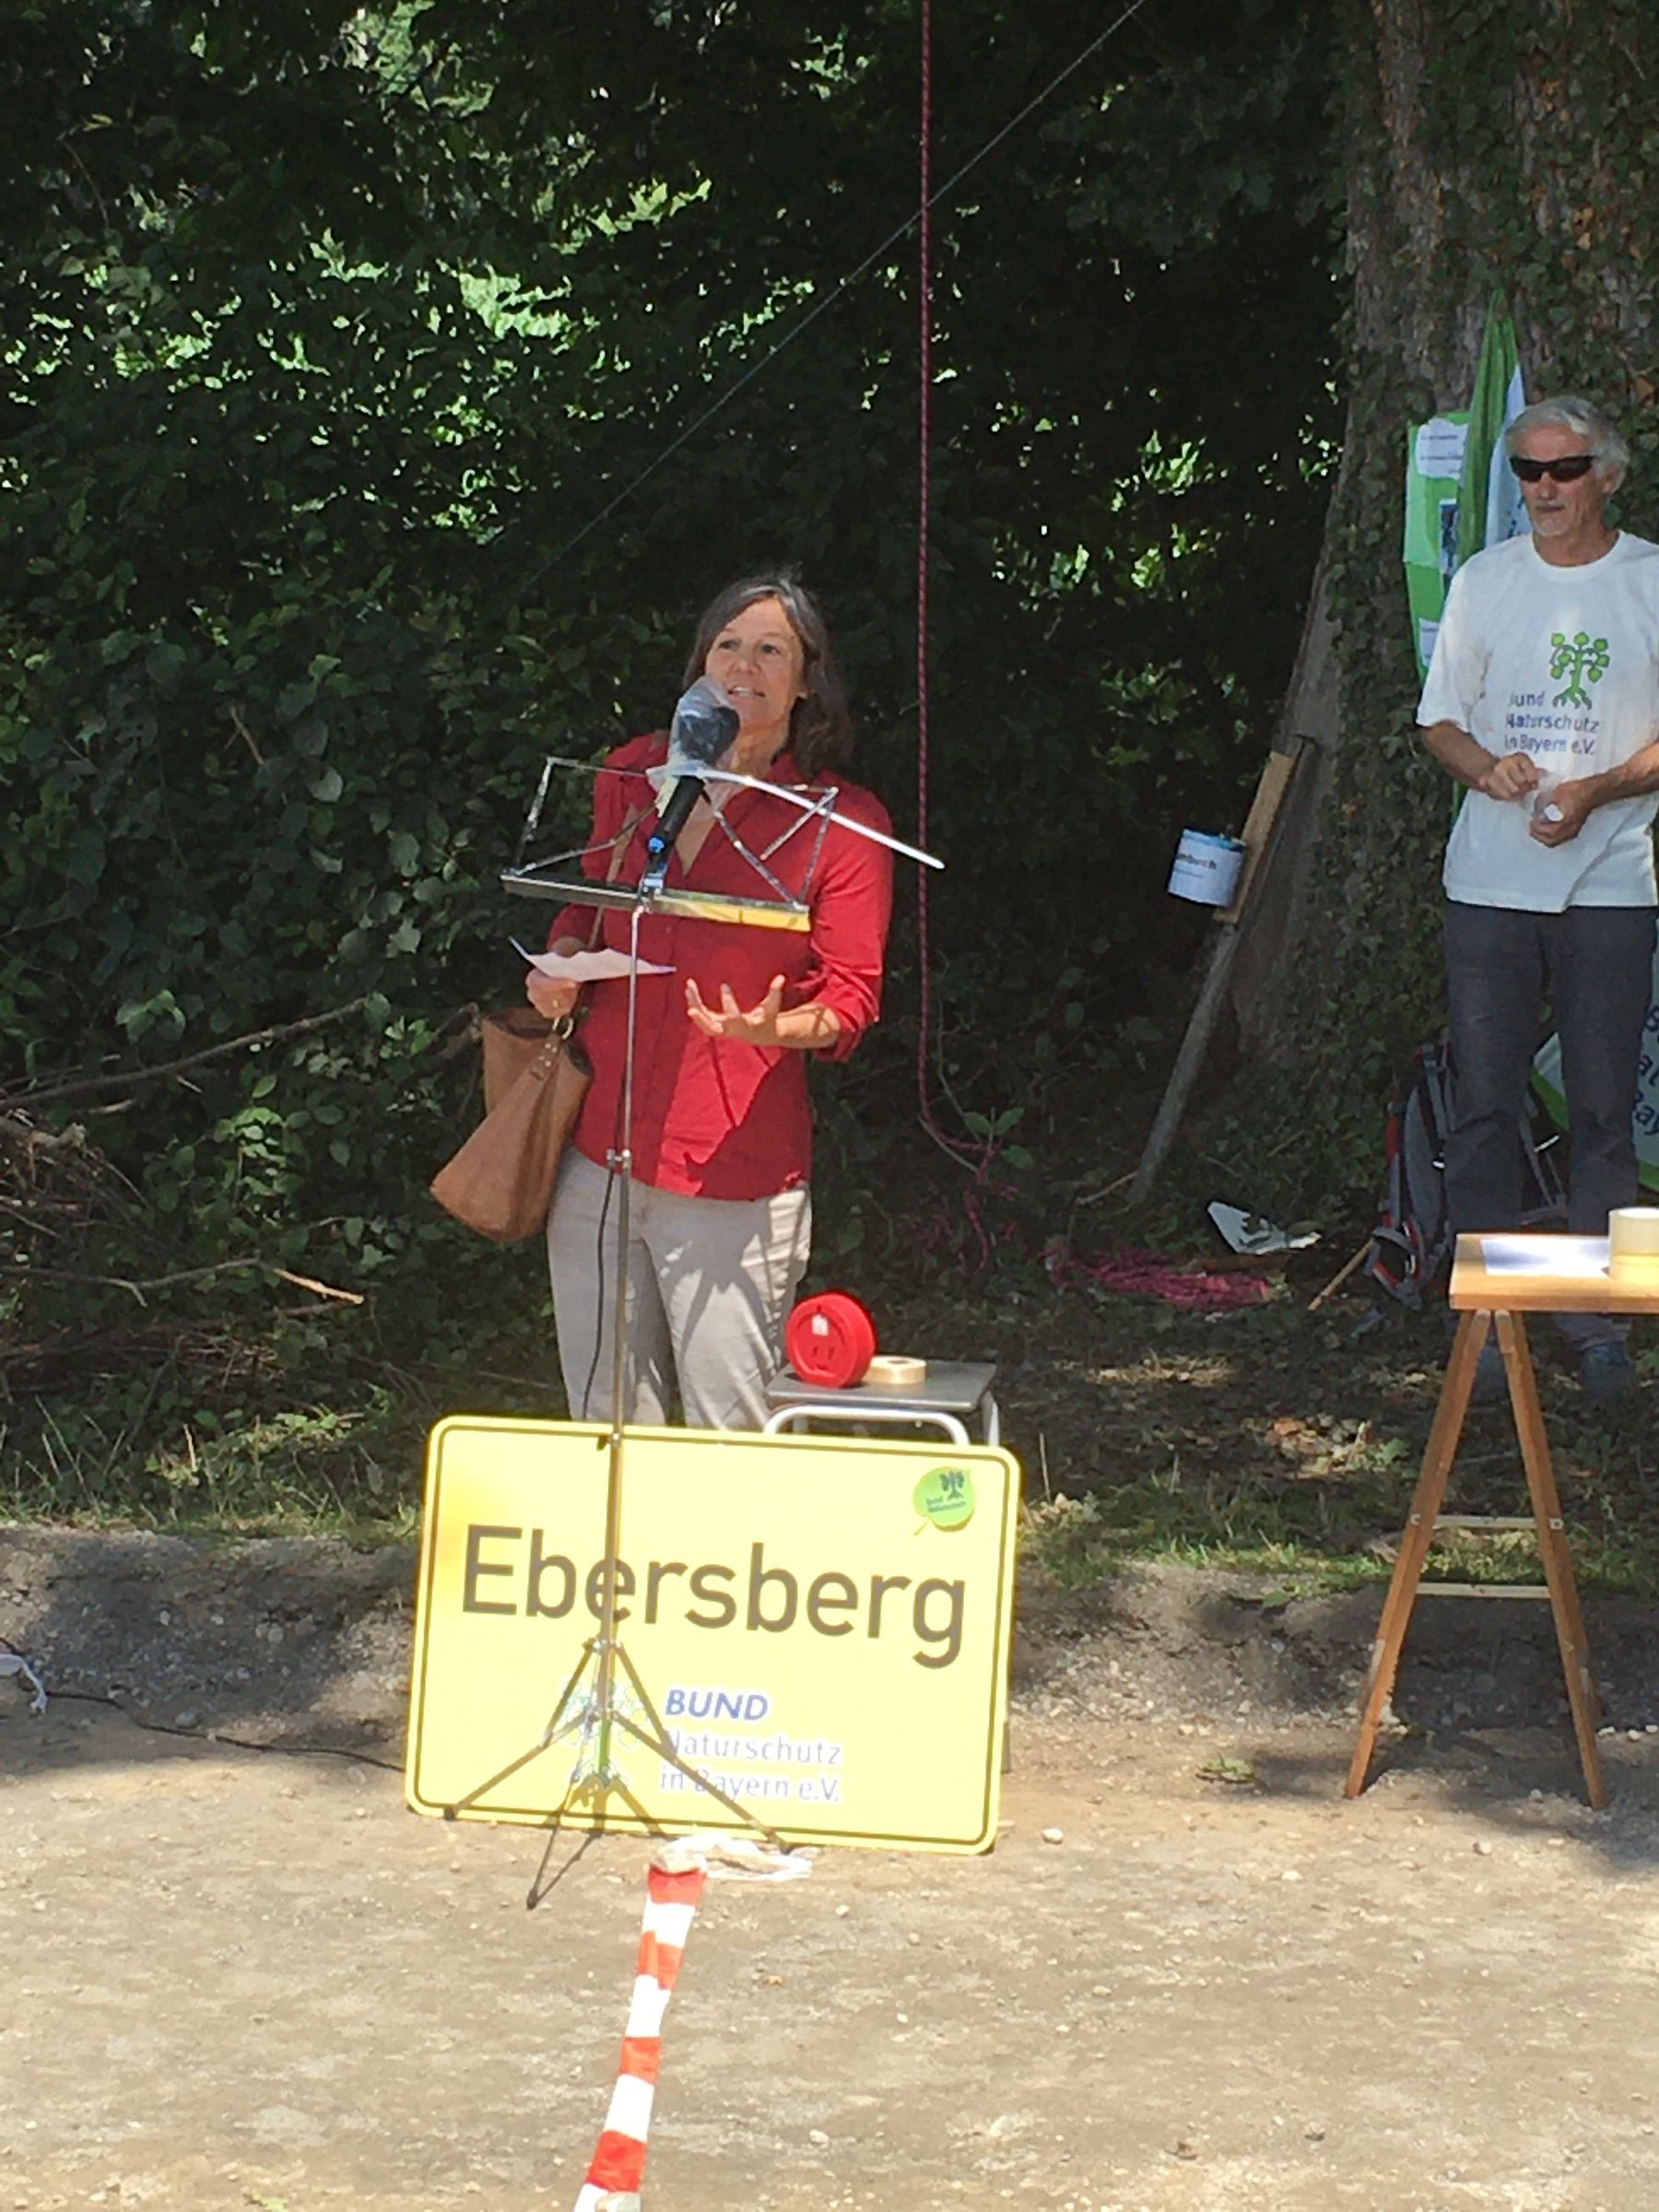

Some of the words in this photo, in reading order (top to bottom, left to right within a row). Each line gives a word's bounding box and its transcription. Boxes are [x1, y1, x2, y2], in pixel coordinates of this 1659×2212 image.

[463, 1524, 965, 1669] Ebersberg
[665, 1689, 769, 1721] BUND
[661, 1765, 684, 1790] in
[798, 1777, 840, 1803] e.V.
